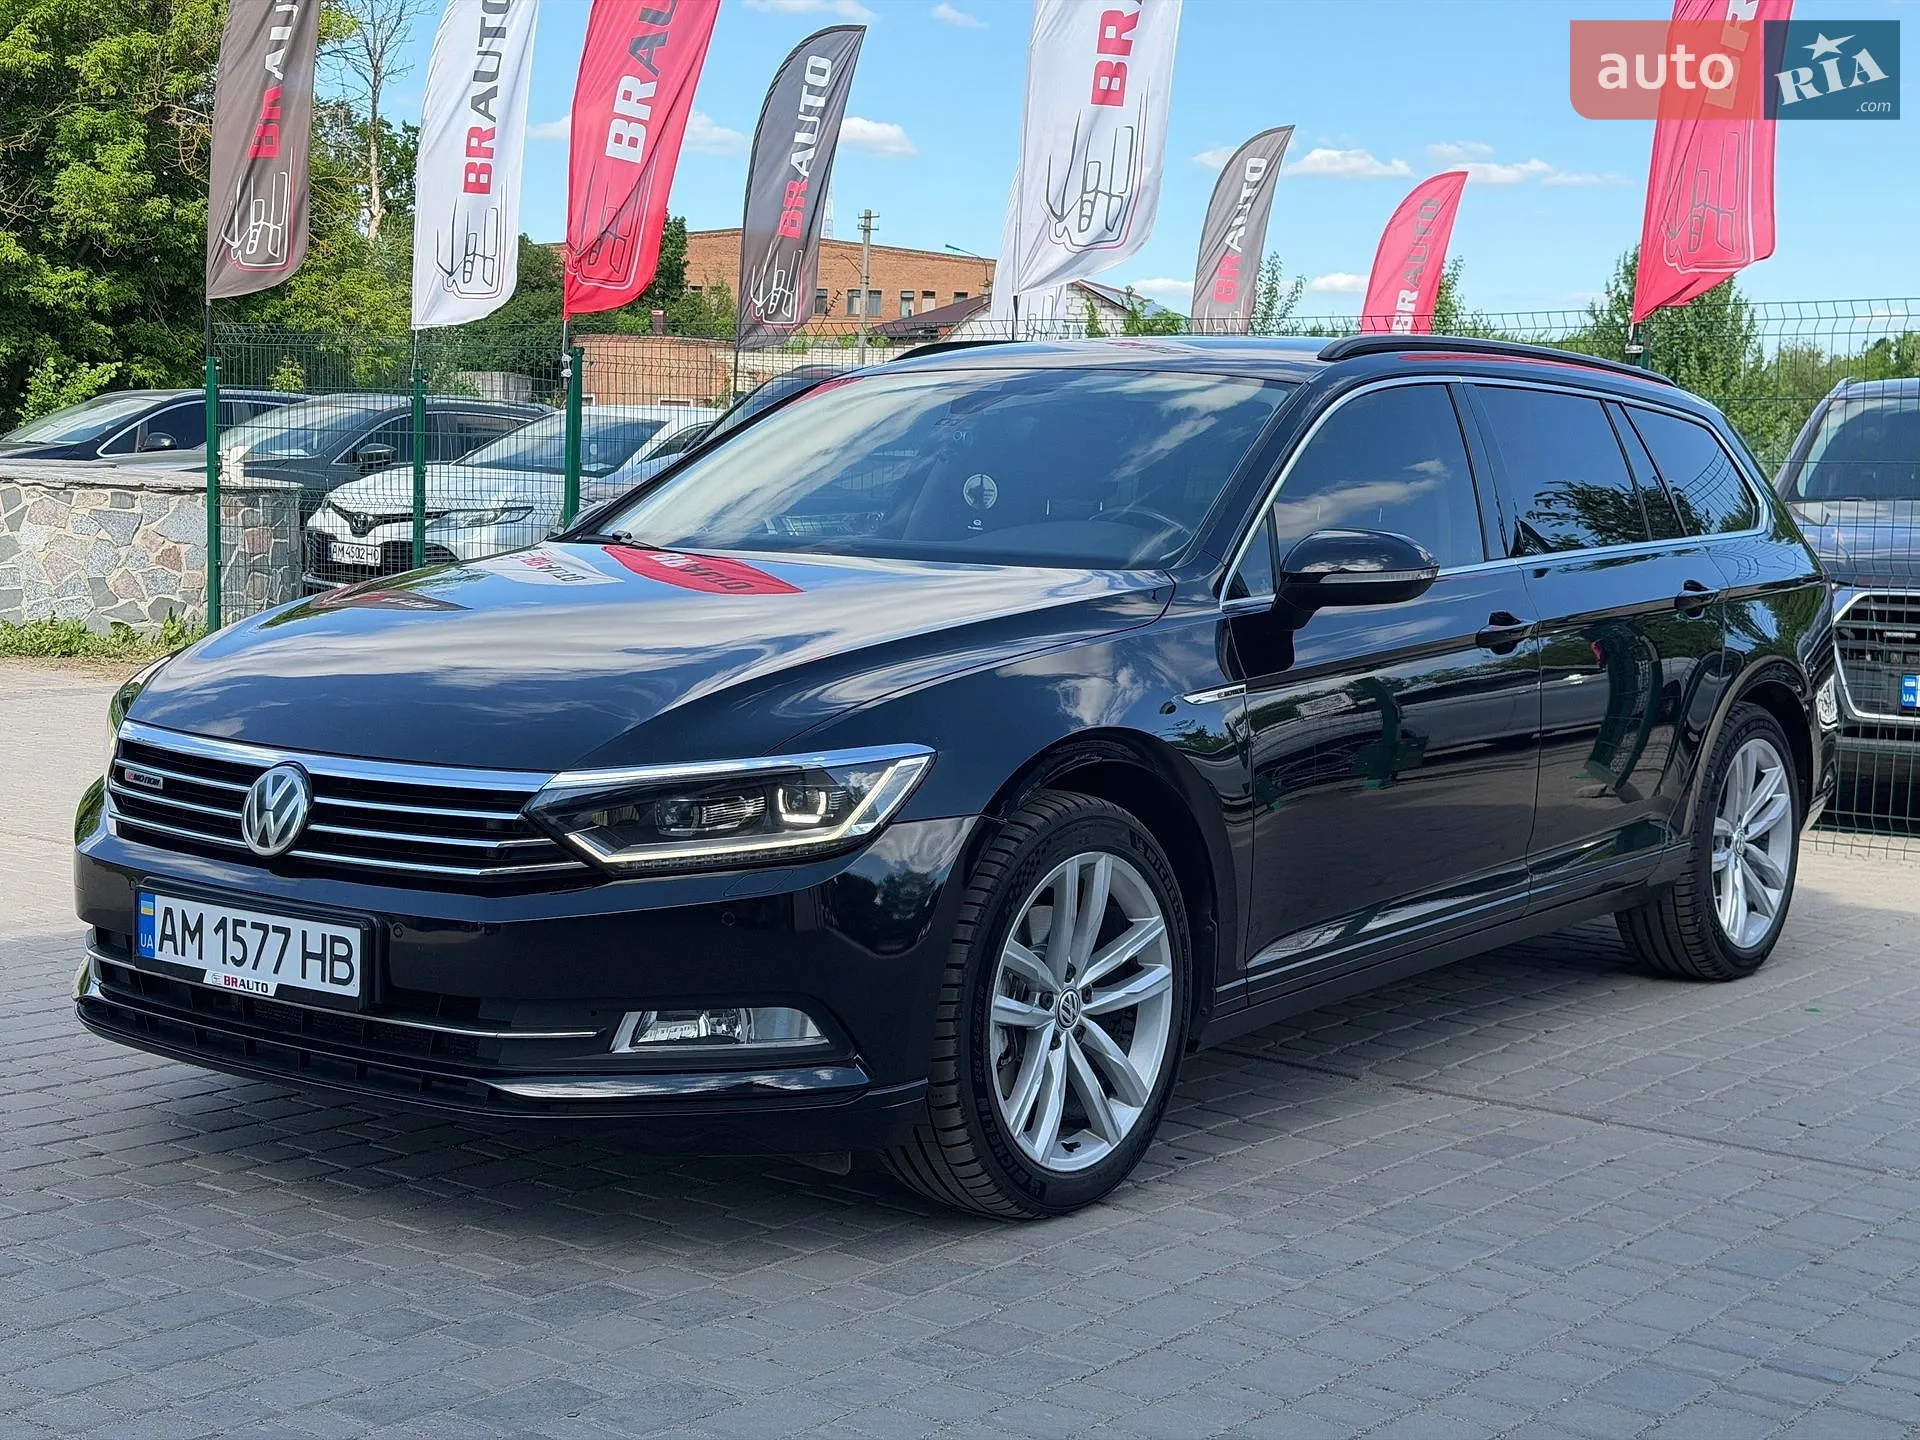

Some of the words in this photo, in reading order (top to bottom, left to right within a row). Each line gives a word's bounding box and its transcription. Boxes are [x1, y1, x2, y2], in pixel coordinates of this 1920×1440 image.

[248, 0, 300, 159] BRAU
[1090, 0, 1142, 108] BR
[777, 55, 831, 239] BRAUTO
[1212, 157, 1267, 304] BRAUTO
[140, 934, 154, 950] UA
[158, 906, 204, 960] AM
[213, 916, 291, 975] 1577
[301, 930, 355, 986] HB
[223, 975, 269, 993] BRAUTO
